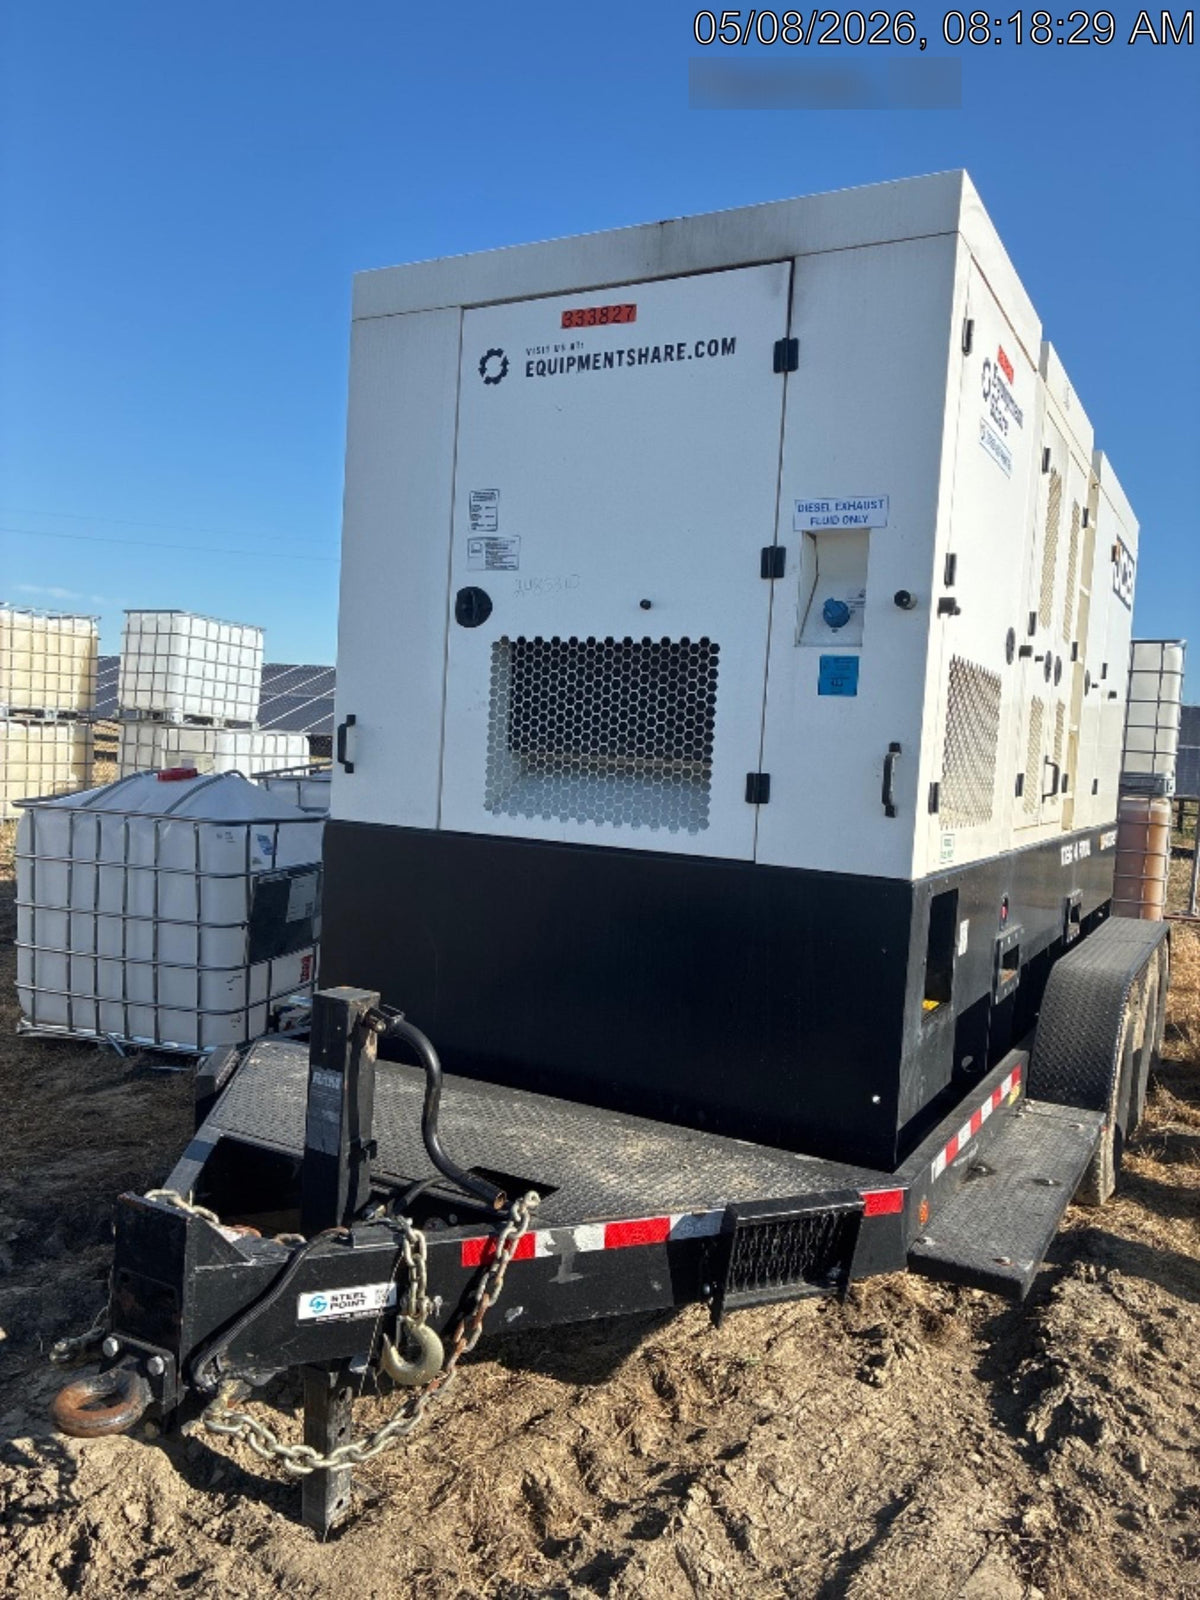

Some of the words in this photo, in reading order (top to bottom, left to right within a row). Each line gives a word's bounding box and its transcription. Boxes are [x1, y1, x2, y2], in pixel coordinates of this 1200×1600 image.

[563, 305, 635, 328] 333827
[526, 344, 550, 356] VISIT
[554, 343, 566, 353] US
[525, 337, 736, 376] EQUIPMENTSHARE.COM
[797, 502, 832, 513] DIESEL
[835, 499, 884, 511] EXHAUST
[810, 516, 840, 526] FLUID
[842, 514, 869, 525] ONLY
[331, 1292, 367, 1302] STEEL
[330, 1300, 365, 1310] POINT
